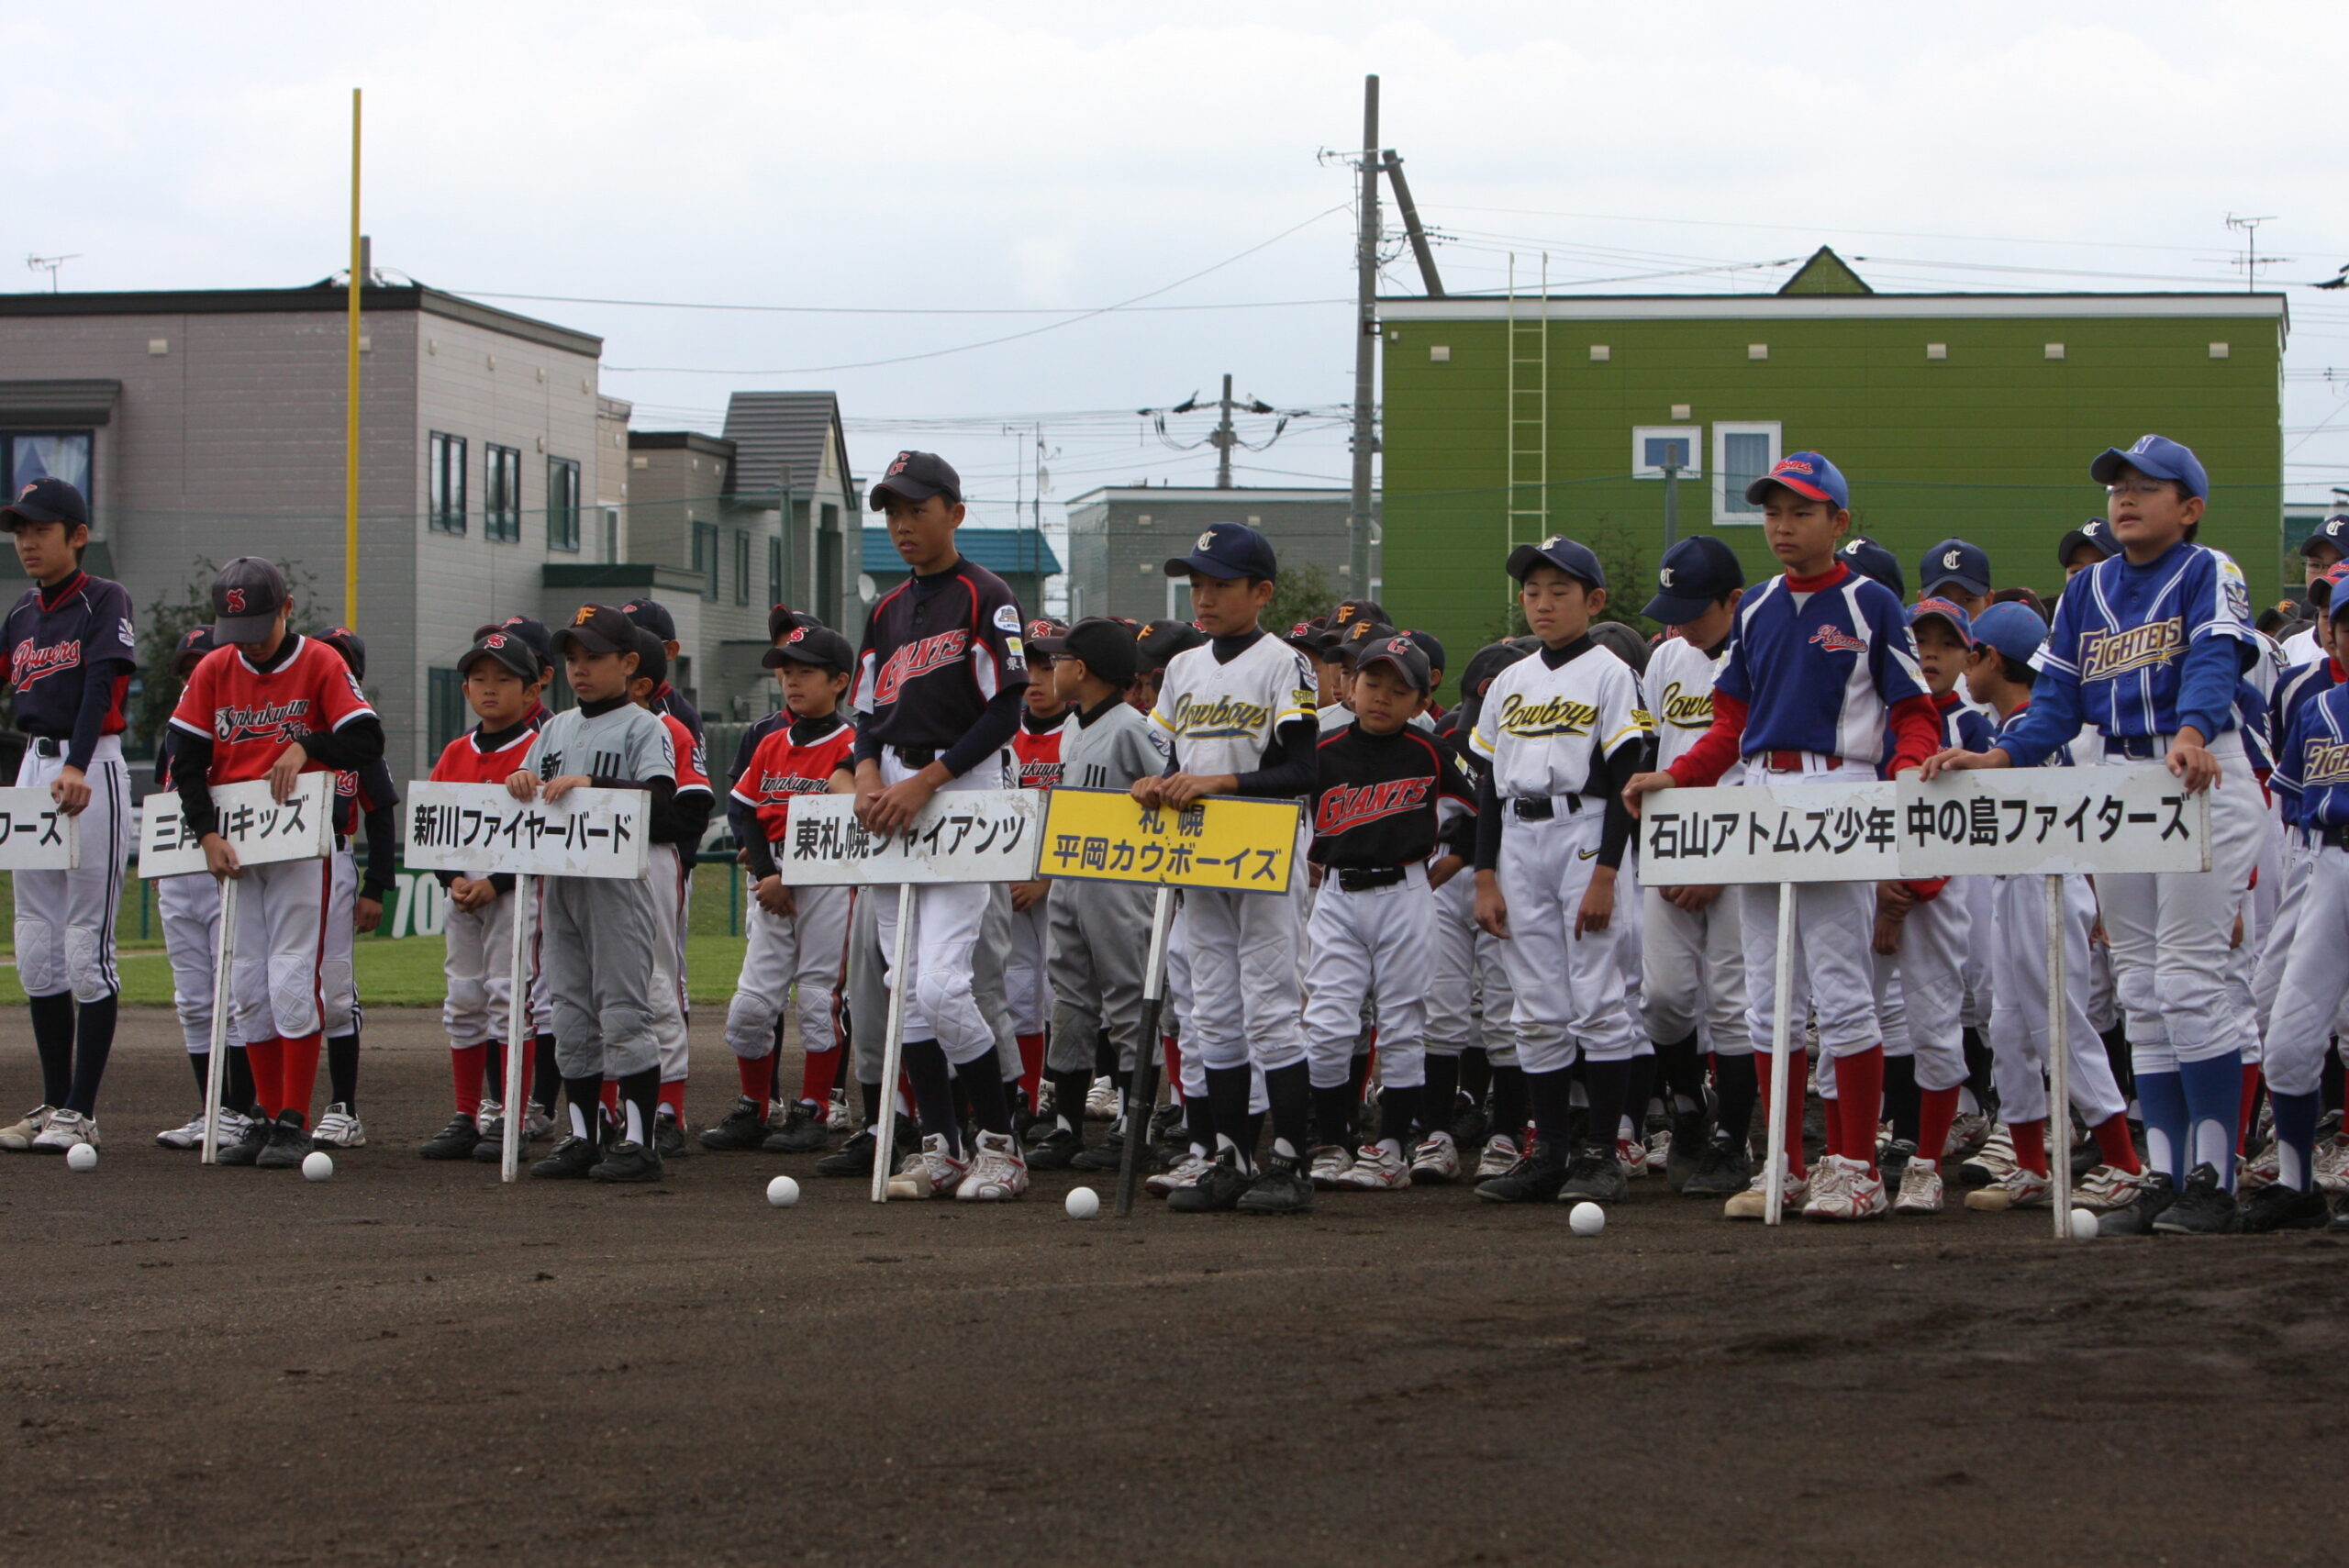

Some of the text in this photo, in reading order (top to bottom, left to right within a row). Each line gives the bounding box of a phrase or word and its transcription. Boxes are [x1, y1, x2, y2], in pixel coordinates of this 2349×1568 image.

[227, 588, 246, 613] S
[576, 606, 596, 626] F
[1337, 606, 1356, 624] F
[1351, 622, 1371, 639] F
[1498, 693, 1599, 732] Cowboys
[1314, 776, 1437, 831] GIANTS
[1907, 795, 2191, 848] 中の島ファイターズ
[413, 803, 632, 854] 新川ファイヤーバード
[1649, 806, 1898, 860] 石山アトムズ少年
[1052, 834, 1282, 882] 平岡カウボーイズ
